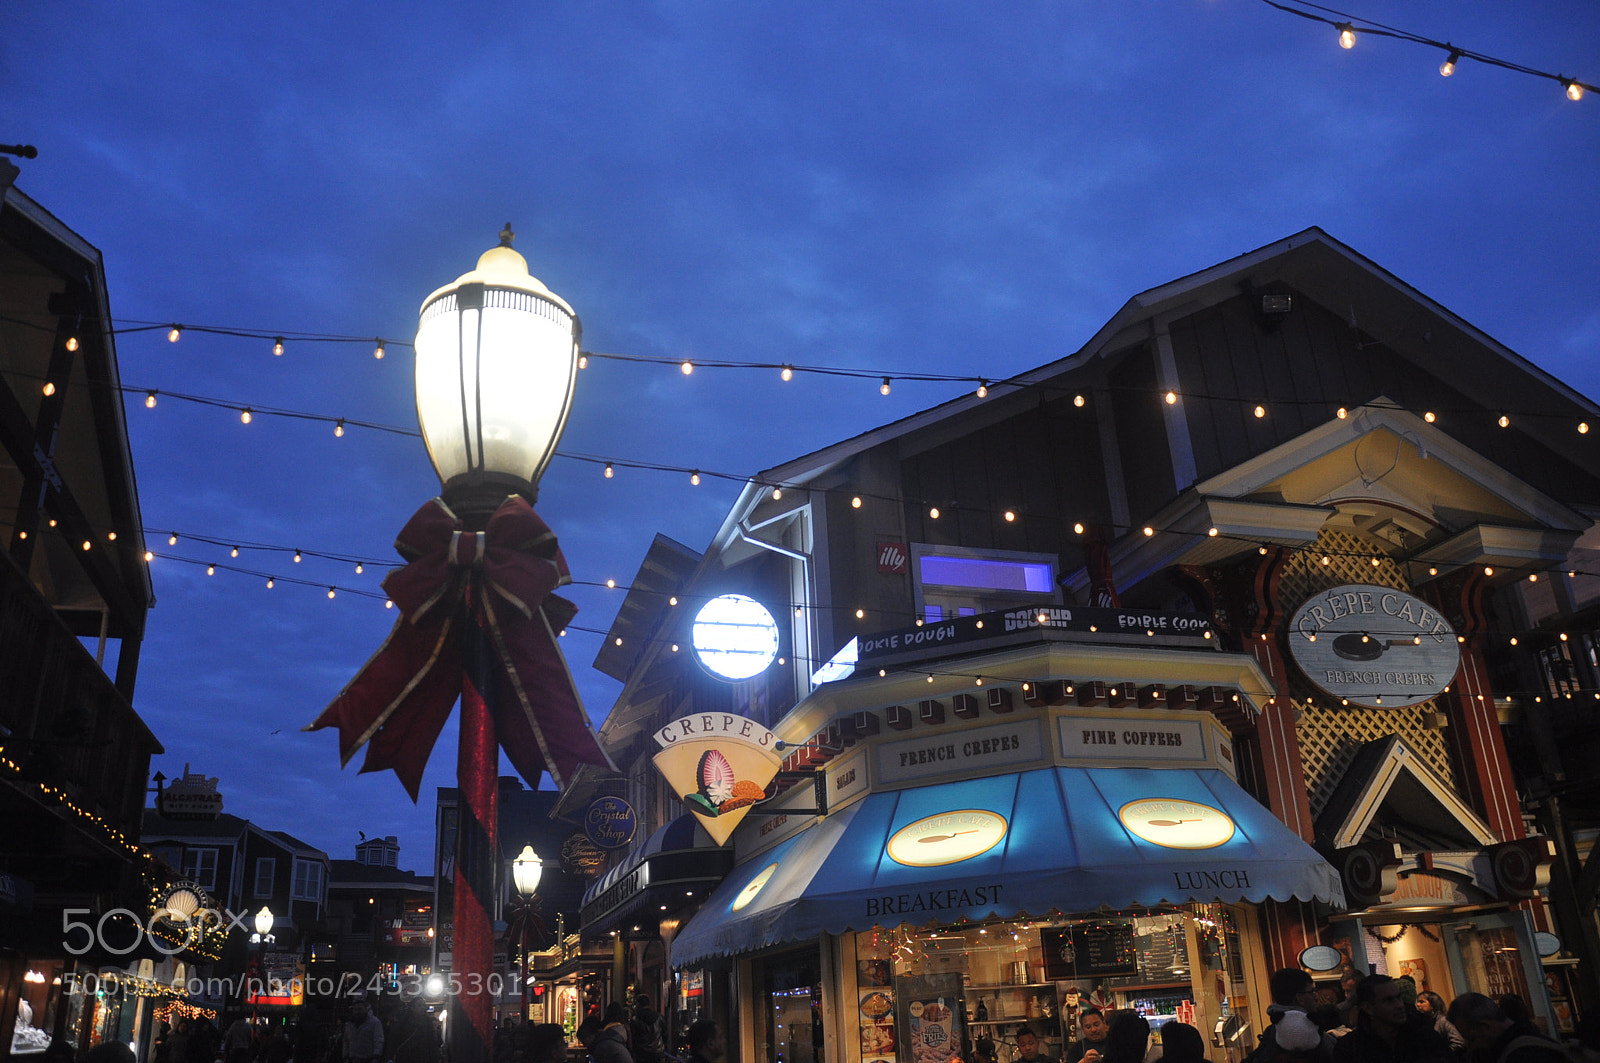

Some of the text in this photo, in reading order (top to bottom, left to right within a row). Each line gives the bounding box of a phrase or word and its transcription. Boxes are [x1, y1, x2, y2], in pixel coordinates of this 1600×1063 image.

[879, 546, 905, 571] illy
[1118, 614, 1167, 629] EDIBLE
[858, 624, 955, 653] OOKIE DOUGH
[1326, 670, 1436, 686] FRENCH CREPES
[661, 715, 774, 746] CREPES
[1082, 730, 1182, 747] FINE COFFEES
[900, 735, 1020, 767] FRENCH CREPES
[589, 807, 631, 826] Crystal
[596, 823, 625, 844] Shop
[1173, 870, 1251, 890] LUNCH
[866, 884, 1003, 917] BREAKFAST
